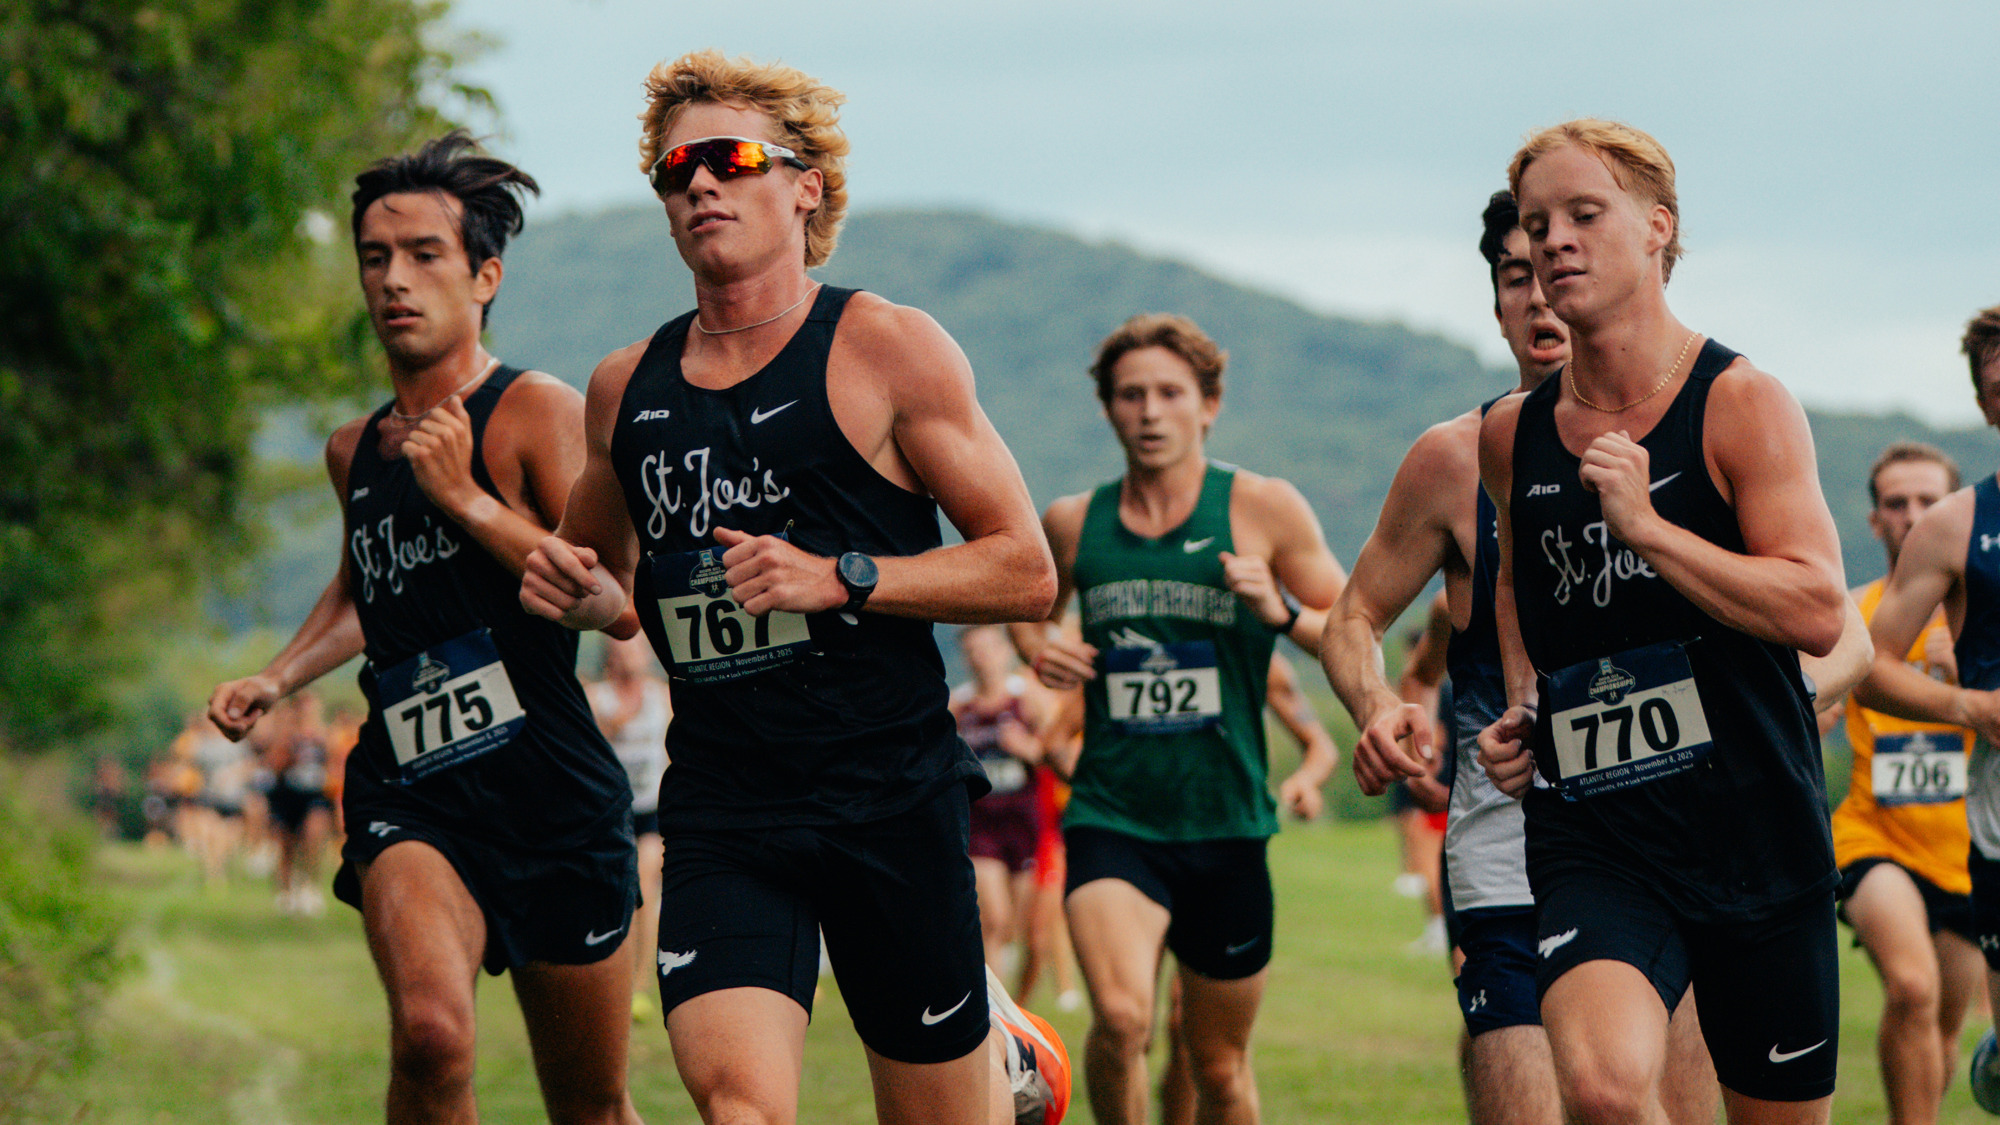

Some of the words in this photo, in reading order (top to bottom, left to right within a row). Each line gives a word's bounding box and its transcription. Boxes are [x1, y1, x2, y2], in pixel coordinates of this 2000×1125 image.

[684, 447, 790, 538] Joe's
[378, 514, 459, 595] Joe's
[675, 599, 772, 660] 767
[735, 652, 768, 667] November
[776, 647, 793, 659] 2025
[401, 680, 494, 756] 775
[1124, 679, 1199, 714] 792
[1570, 697, 1680, 771] 770
[1579, 773, 1605, 787] ATLANTIC
[1605, 766, 1630, 780] REGION
[1634, 757, 1668, 772] November
[1669, 754, 1676, 765] 8,
[1677, 750, 1694, 762] 2025
[1629, 776, 1641, 786] Lock
[1889, 760, 1950, 790] 706
